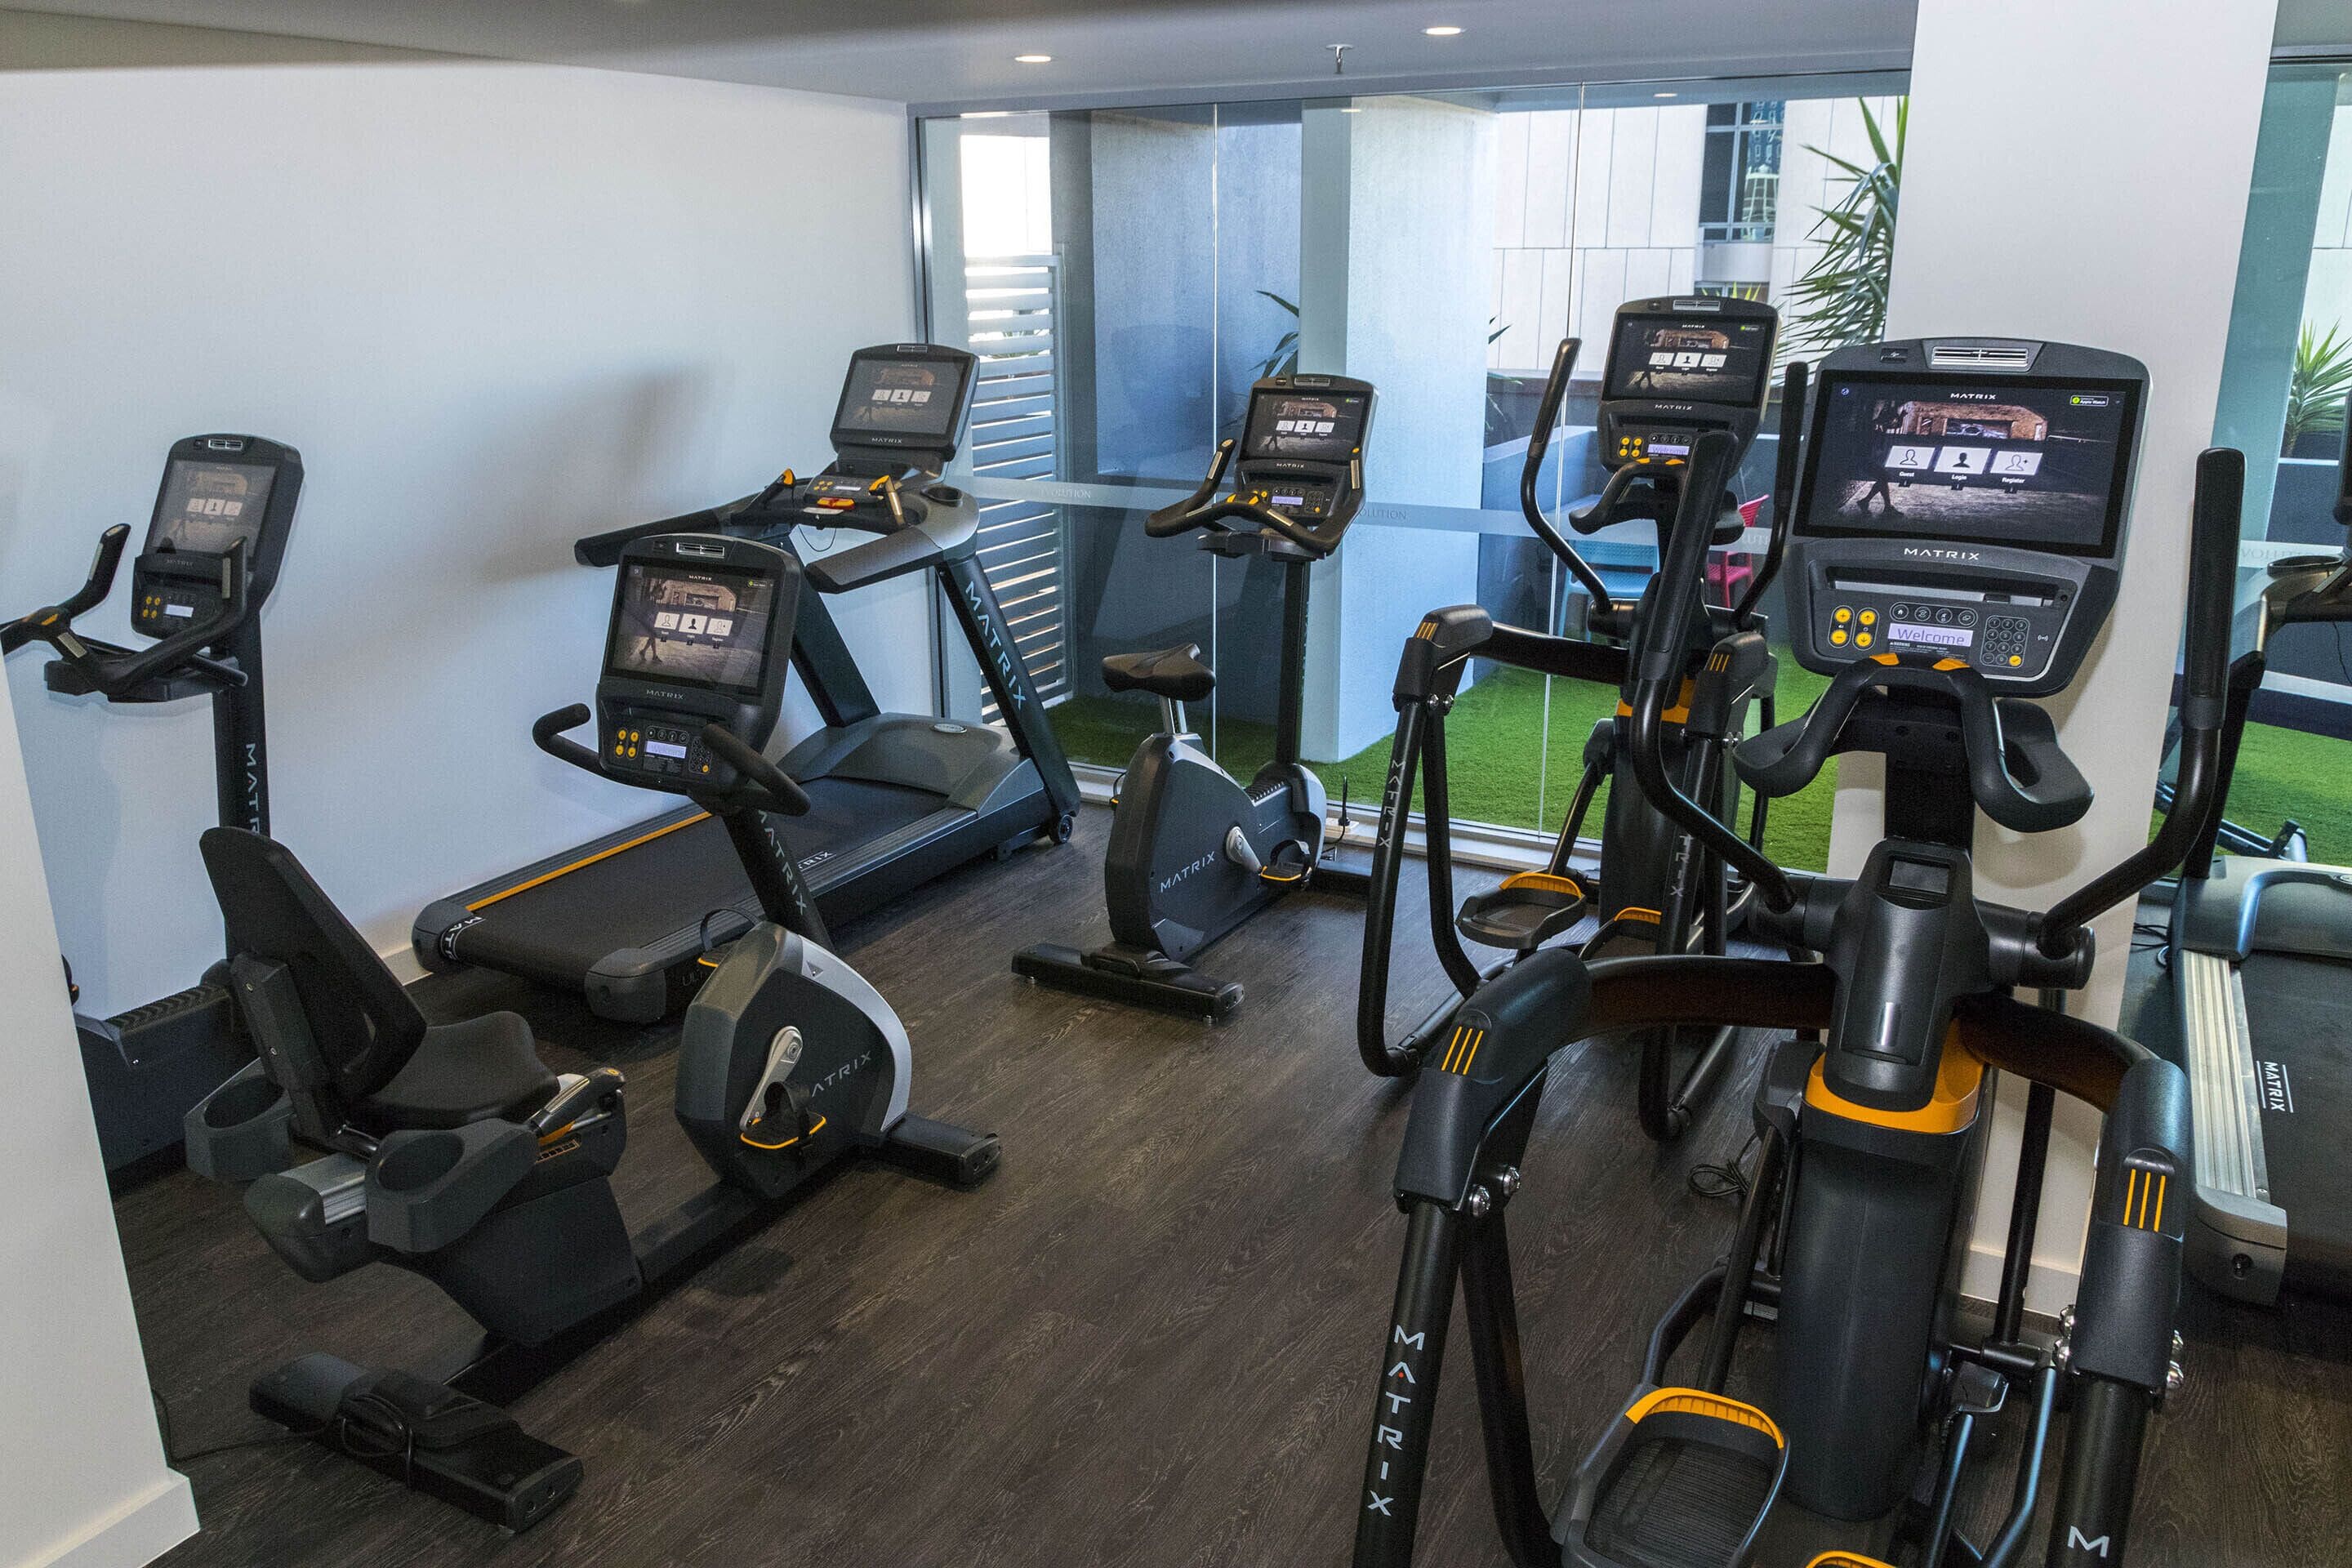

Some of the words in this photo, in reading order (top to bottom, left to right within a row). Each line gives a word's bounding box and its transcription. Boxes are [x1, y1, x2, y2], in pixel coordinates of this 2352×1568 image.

[1655, 403, 1693, 412] MATRIX
[1950, 392, 1997, 401] MATRIX
[871, 436, 903, 444] MATRIX
[1359, 508, 1407, 520] OLUTION
[1904, 546, 1980, 561] MATRIX
[965, 581, 1027, 710] MATRIX
[1897, 628, 1965, 646] Welcome
[646, 689, 684, 701] MATRIX
[246, 743, 260, 835] MATR
[1379, 760, 1406, 847] MATRIX
[1160, 851, 1215, 893] MATRIX
[1671, 835, 1694, 897] TRIX
[445, 916, 482, 960] MATR
[812, 1050, 871, 1098] ATRIX
[2265, 1062, 2286, 1112] MATRIX
[1368, 1325, 1425, 1517] MATRIX
